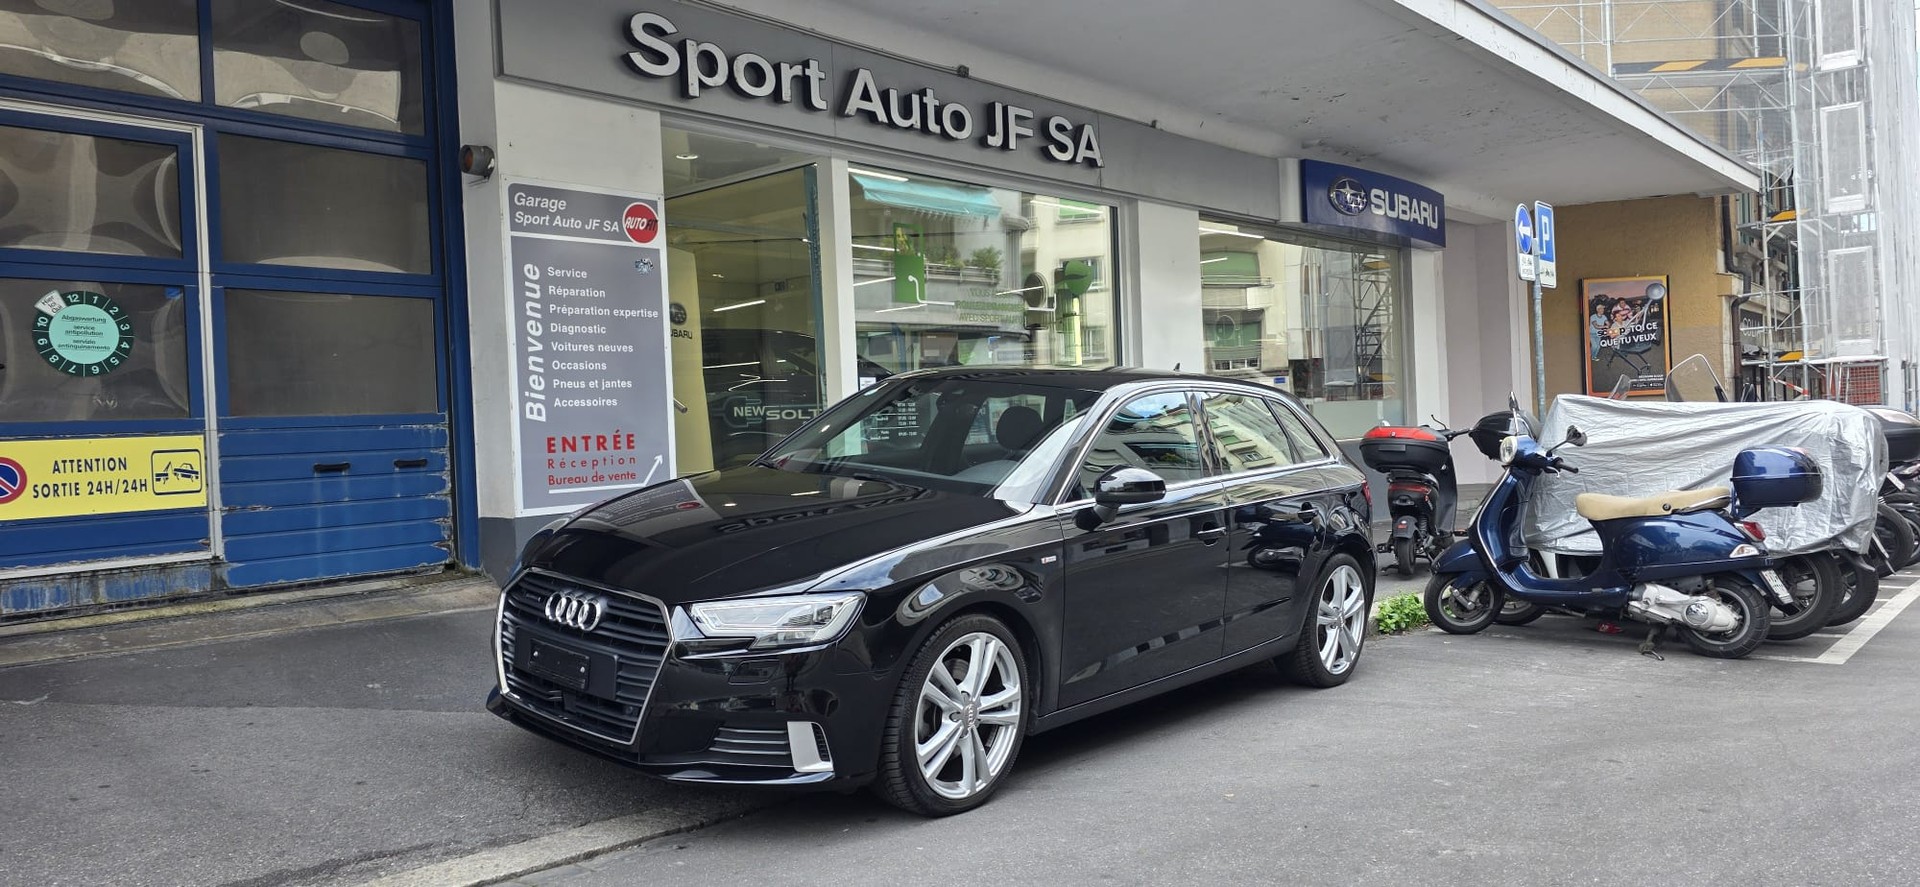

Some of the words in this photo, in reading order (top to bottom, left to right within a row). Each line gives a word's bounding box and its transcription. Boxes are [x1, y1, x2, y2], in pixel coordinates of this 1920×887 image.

[626, 11, 828, 111] Sport
[844, 68, 973, 140] Auto
[985, 101, 1034, 150] JF
[1045, 115, 1104, 168] SA
[514, 192, 567, 213] Garage
[1370, 188, 1438, 230] SUBARU
[515, 211, 550, 226] Sport
[552, 215, 582, 229] Auto
[585, 218, 601, 230] JF
[603, 220, 620, 233] SA
[1540, 214, 1550, 255] P
[547, 266, 588, 279] Service
[548, 285, 606, 298] Réparation
[67, 293, 80, 303] 12
[92, 296, 99, 304] 1
[109, 306, 119, 315] 2
[549, 304, 610, 316] Préparation
[613, 307, 659, 319] expertise
[37, 316, 48, 327] 10
[120, 323, 130, 331] 3
[1646, 322, 1658, 330] CE
[550, 322, 607, 335] Diagnostic
[670, 329, 693, 340] BARU
[1600, 338, 1619, 347] QUE
[1620, 336, 1631, 345] TU
[1632, 333, 1657, 343] VEUX
[37, 338, 48, 346] 9
[120, 341, 130, 349] 4
[523, 263, 547, 422] Bienvenue
[551, 342, 594, 352] Voitures
[598, 344, 634, 352] neuves
[48, 354, 59, 363] 8
[109, 356, 119, 365] 5
[68, 365, 76, 374] 7
[91, 365, 100, 374] 6
[552, 360, 607, 370] Occasions
[553, 379, 586, 389] Pneus
[589, 380, 598, 389] et
[601, 379, 632, 391] jantes
[554, 397, 618, 408] Accessoires
[734, 406, 766, 417] NEW
[546, 429, 636, 454] ENTRÉE
[52, 456, 128, 474] ATTENTION
[547, 455, 636, 470] Réception
[548, 474, 588, 486] Bureau
[591, 471, 605, 482] de
[608, 471, 637, 481] vente
[32, 481, 80, 499] SORTIE
[87, 478, 148, 496] 24H/24H
